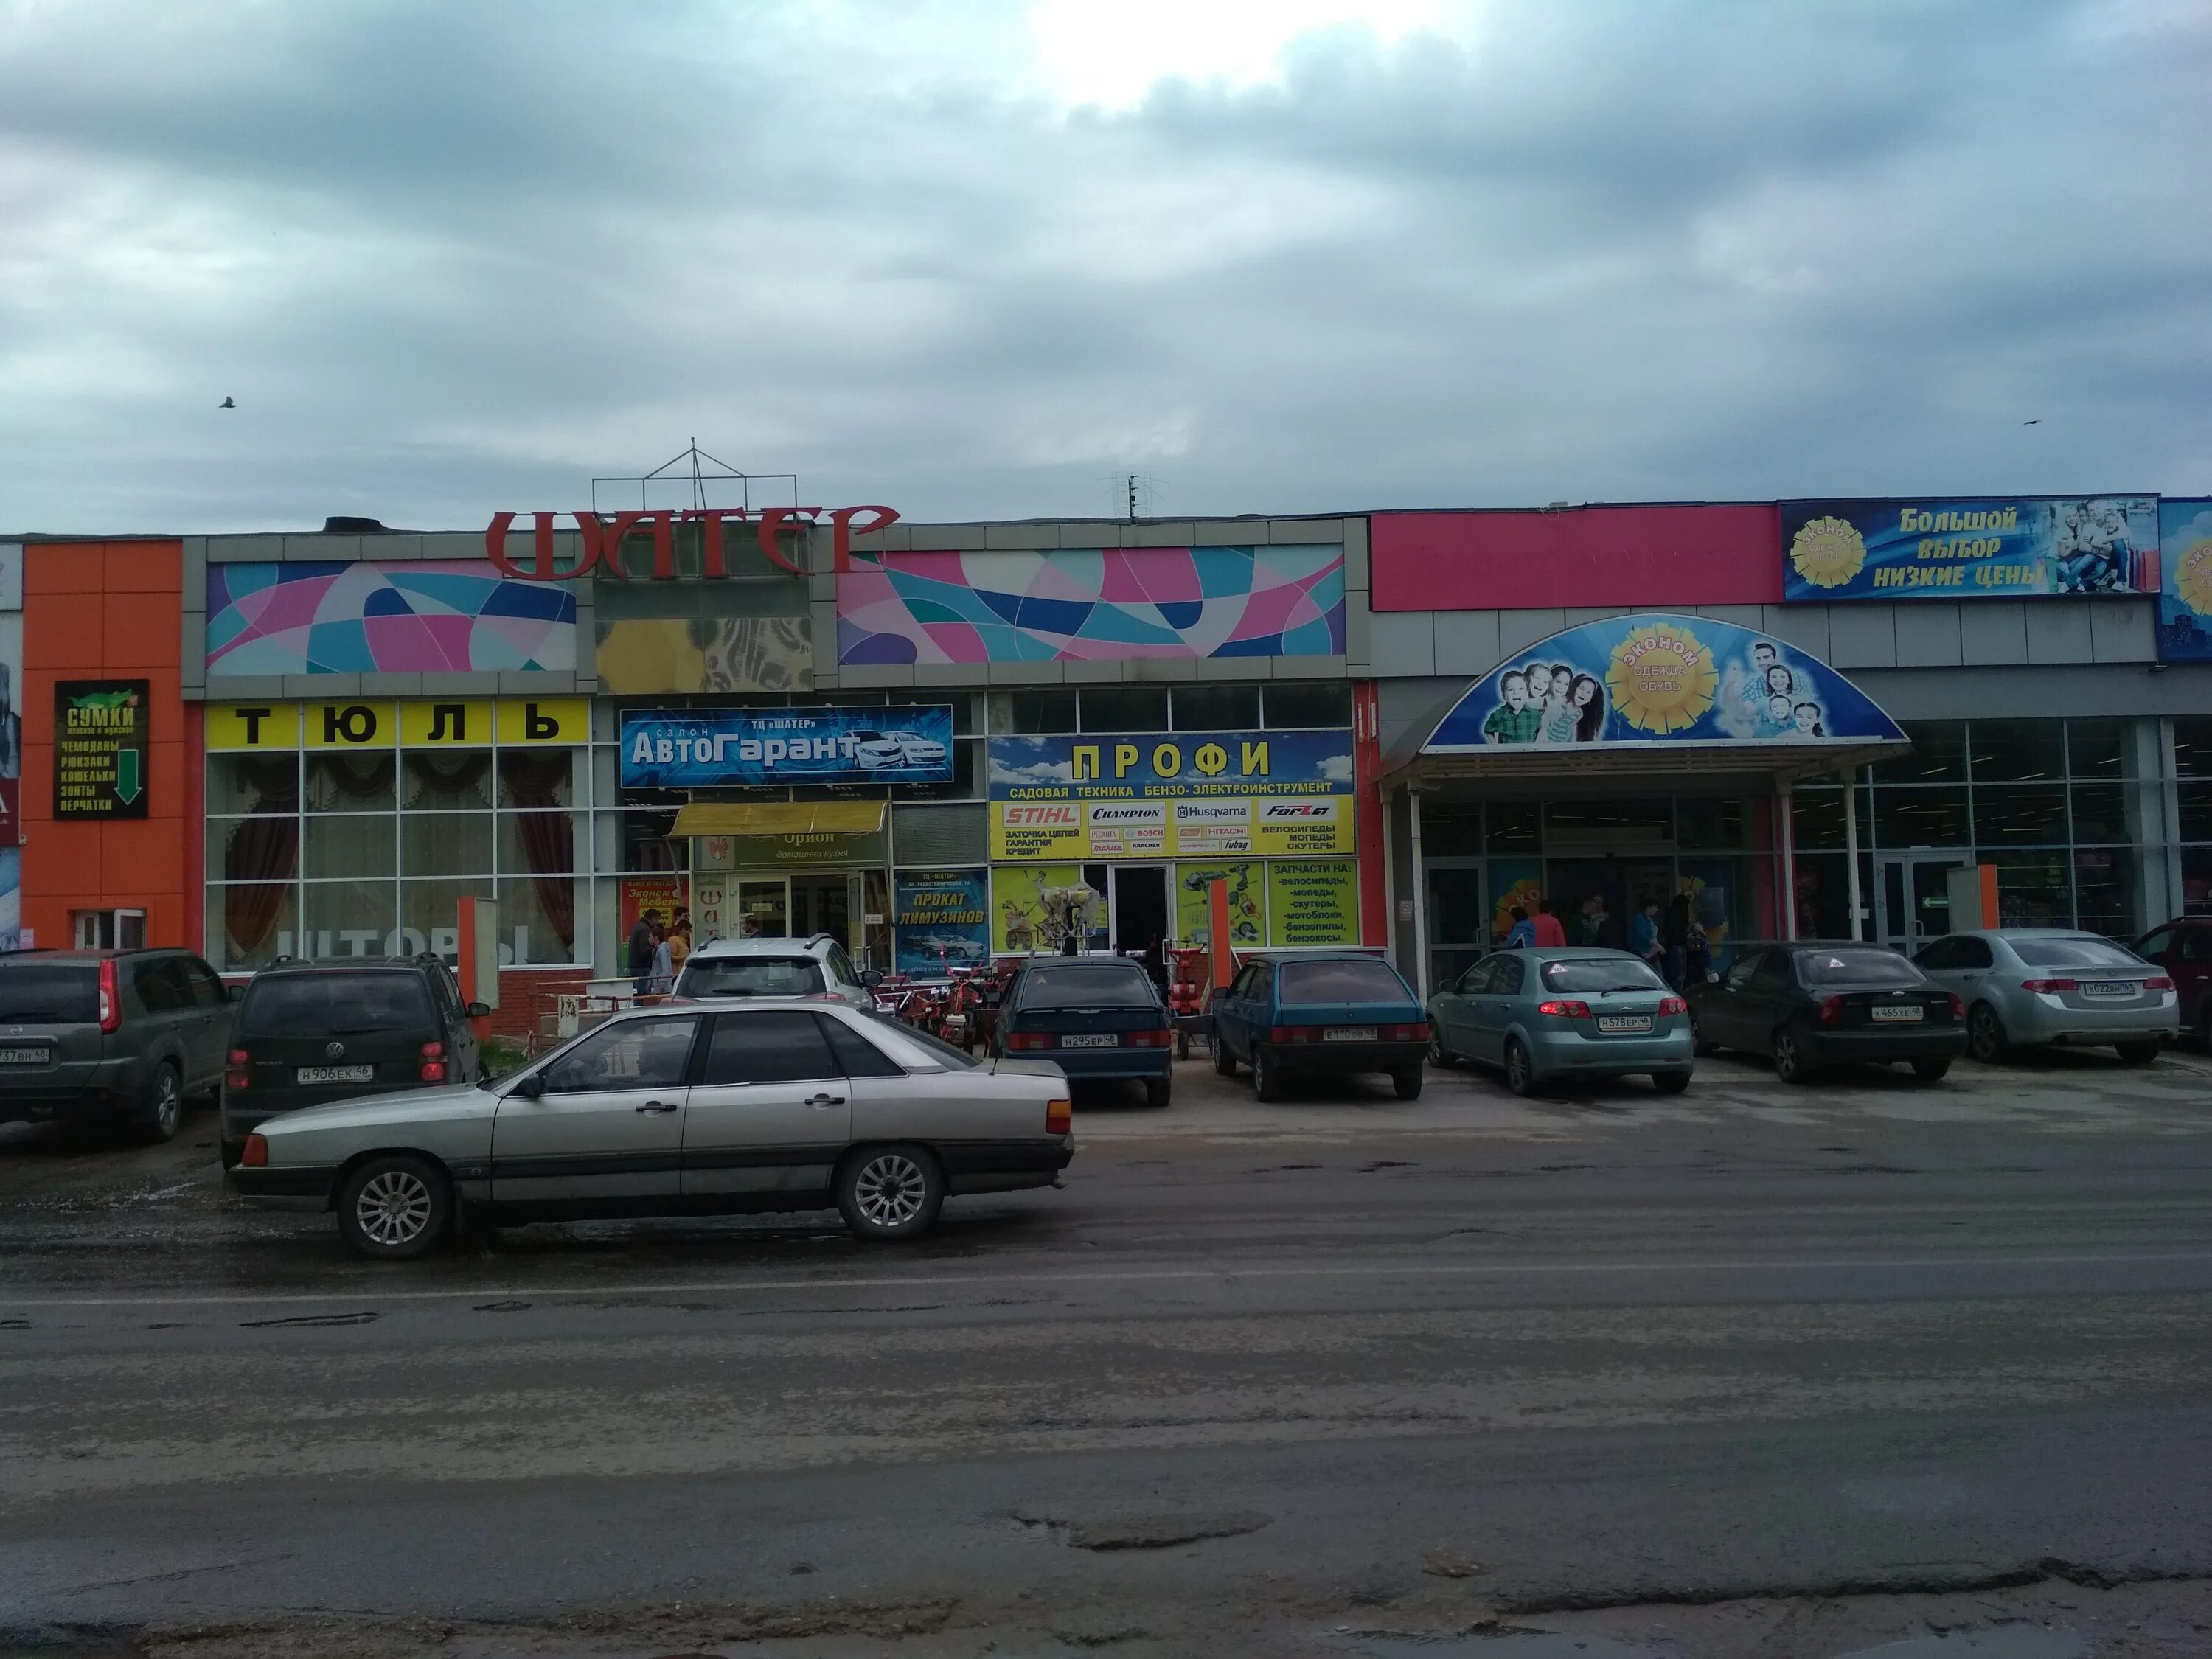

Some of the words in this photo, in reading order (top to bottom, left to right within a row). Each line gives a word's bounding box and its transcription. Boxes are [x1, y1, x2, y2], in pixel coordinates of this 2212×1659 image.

[1802, 525, 1853, 545] ЭКОНОМ
[1917, 538, 2002, 560] ВЫБОР
[1874, 566, 1965, 587] НИЗКИЕ
[1975, 566, 2047, 589] ЦЕНЫ
[1622, 636, 1699, 667] ЭКОНОМ
[1633, 666, 1687, 678] ОДЕЖДА
[1639, 682, 1682, 692] ОБУВЬ
[67, 707, 134, 727] СУМКИ
[751, 720, 765, 731] ТЦ
[769, 719, 815, 730] «ШАТЕР»
[656, 728, 709, 737] салон
[61, 740, 119, 754] ЧЕМОДАНЫ
[60, 756, 110, 768] РЮКЗАКИ
[1071, 741, 1269, 780] ПРОФИ
[60, 771, 116, 782] КОШЕЛЬКИ
[60, 785, 95, 797] ЗОНТЫ
[1009, 787, 1069, 799] САДОВАЯ
[1076, 785, 1134, 797] ТЕХНИКА
[1192, 781, 1332, 795] ЭЛЕКТРОИНСТРУМЕНТ
[60, 799, 112, 812] ПЕРЧАТКИ
[1006, 807, 1076, 824] STIHL
[1189, 806, 1247, 820] Husqvarna
[1005, 830, 1047, 838] ЗАТОЧКА
[1049, 828, 1079, 838] ЦЕПЕЙ
[1262, 825, 1335, 833] ВЕЛОСИПЕДЫ
[1005, 839, 1052, 847] ГАРАНТИЯ
[1289, 833, 1335, 842] МОПЕДЫ
[1005, 847, 1041, 855] КРЕДИТ
[1287, 842, 1336, 850] СКУТЕРЫ
[776, 849, 821, 859] домашняя
[823, 849, 849, 859] кухня
[1274, 864, 1330, 874] ЗАПЧАСТИ
[1333, 863, 1351, 873] НА:
[628, 888, 671, 897] Эконом
[913, 893, 966, 906] ПРОКАТ
[1290, 900, 1338, 910] -скутеры,
[900, 911, 984, 925] ЛИМУЗИНОВ
[1065, 1035, 1102, 1046] Н295ЕР
[302, 1068, 352, 1080] Н906ЕК
